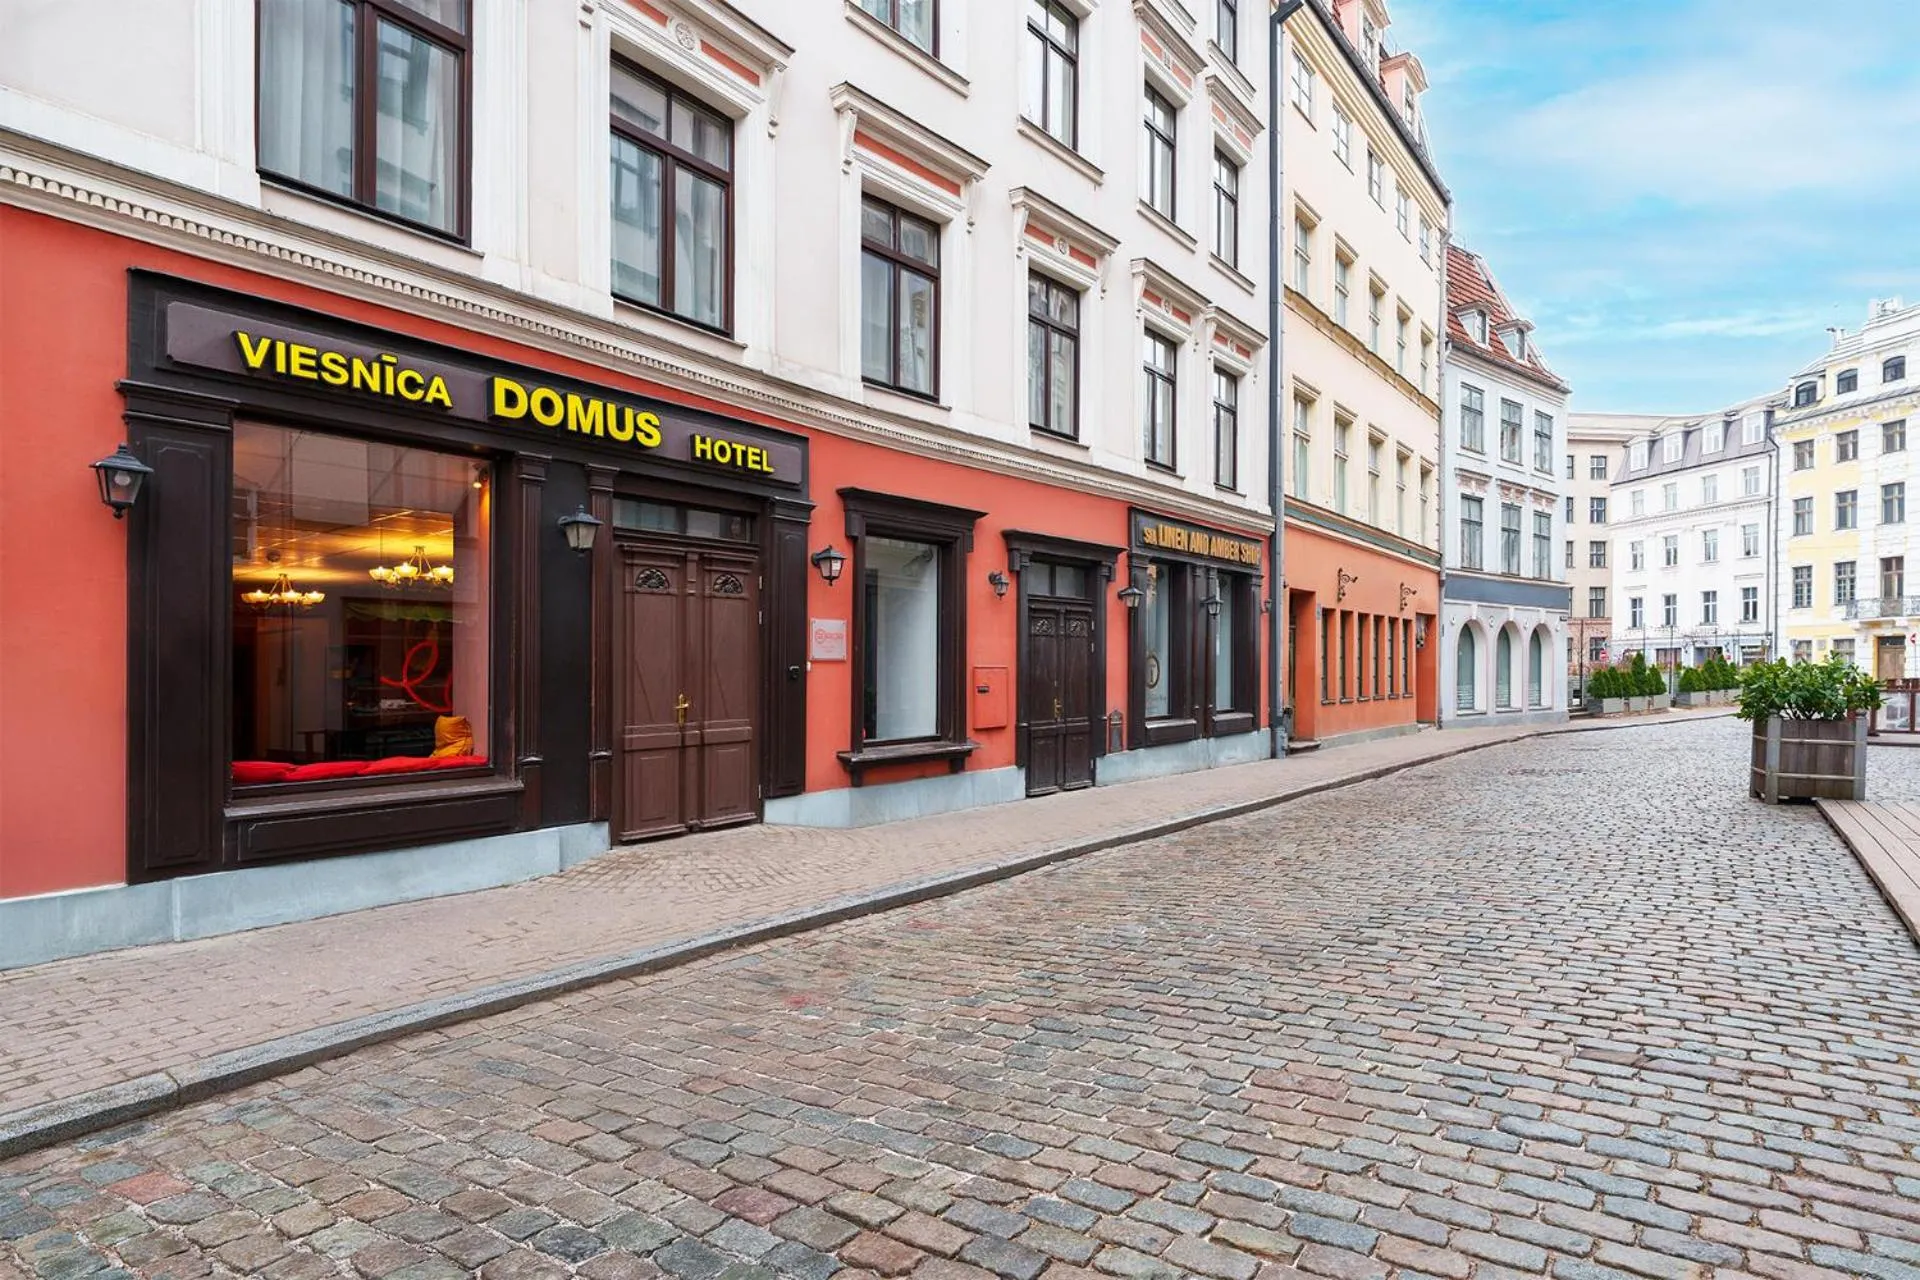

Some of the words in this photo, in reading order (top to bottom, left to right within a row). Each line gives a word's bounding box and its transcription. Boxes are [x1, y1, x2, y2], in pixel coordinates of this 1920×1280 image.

[237, 332, 452, 408] VIESNĪCA
[493, 376, 662, 448] DOMUS
[694, 435, 775, 473] HOTEL
[1159, 525, 1188, 550] LINEN
[1190, 532, 1209, 554] AND
[1211, 536, 1239, 560] AMBER
[1240, 543, 1261, 565] SHOP
